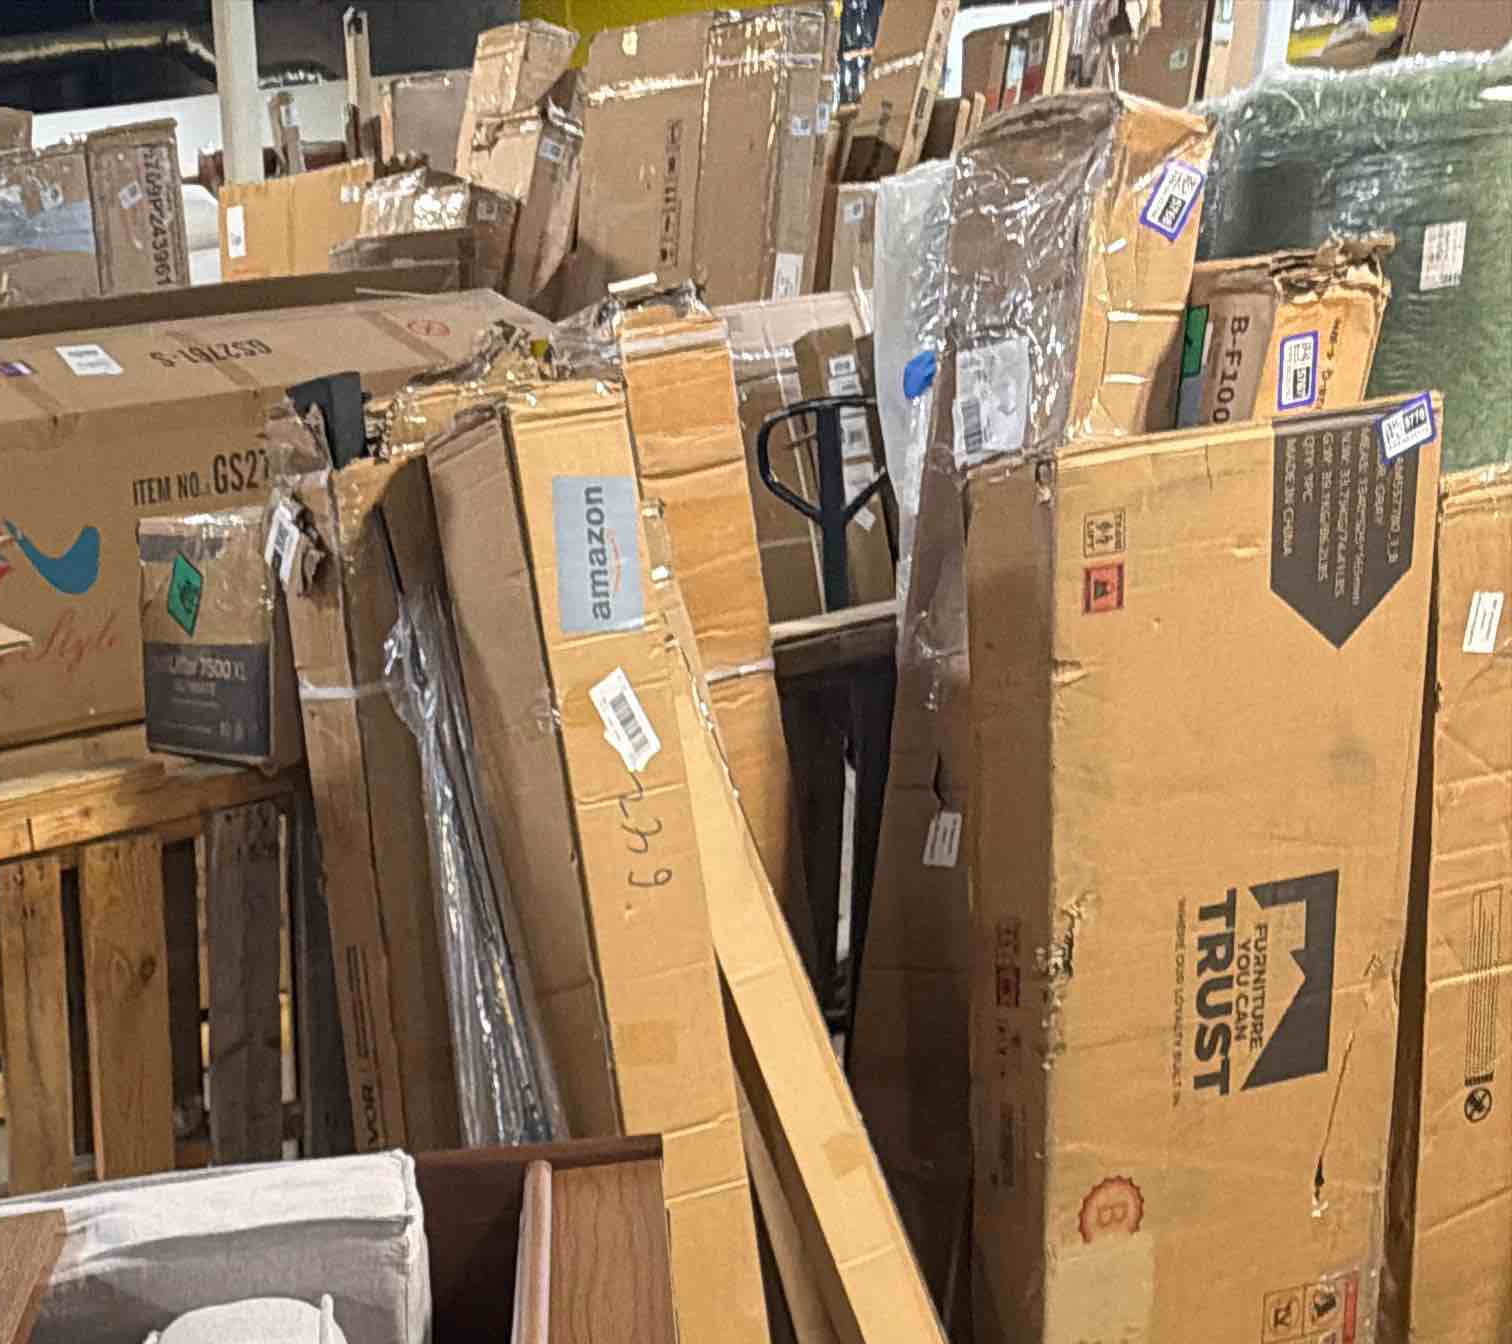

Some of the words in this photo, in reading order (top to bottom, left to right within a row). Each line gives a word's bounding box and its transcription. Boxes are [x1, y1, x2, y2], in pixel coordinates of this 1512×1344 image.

[133, 476, 171, 506] ITEM
[584, 486, 612, 621] amazon
[1193, 888, 1237, 1096] TRUST
[1236, 938, 1252, 986] YOU
[1249, 920, 1268, 1051] FURNITURE
[1234, 993, 1250, 1041] CAN
